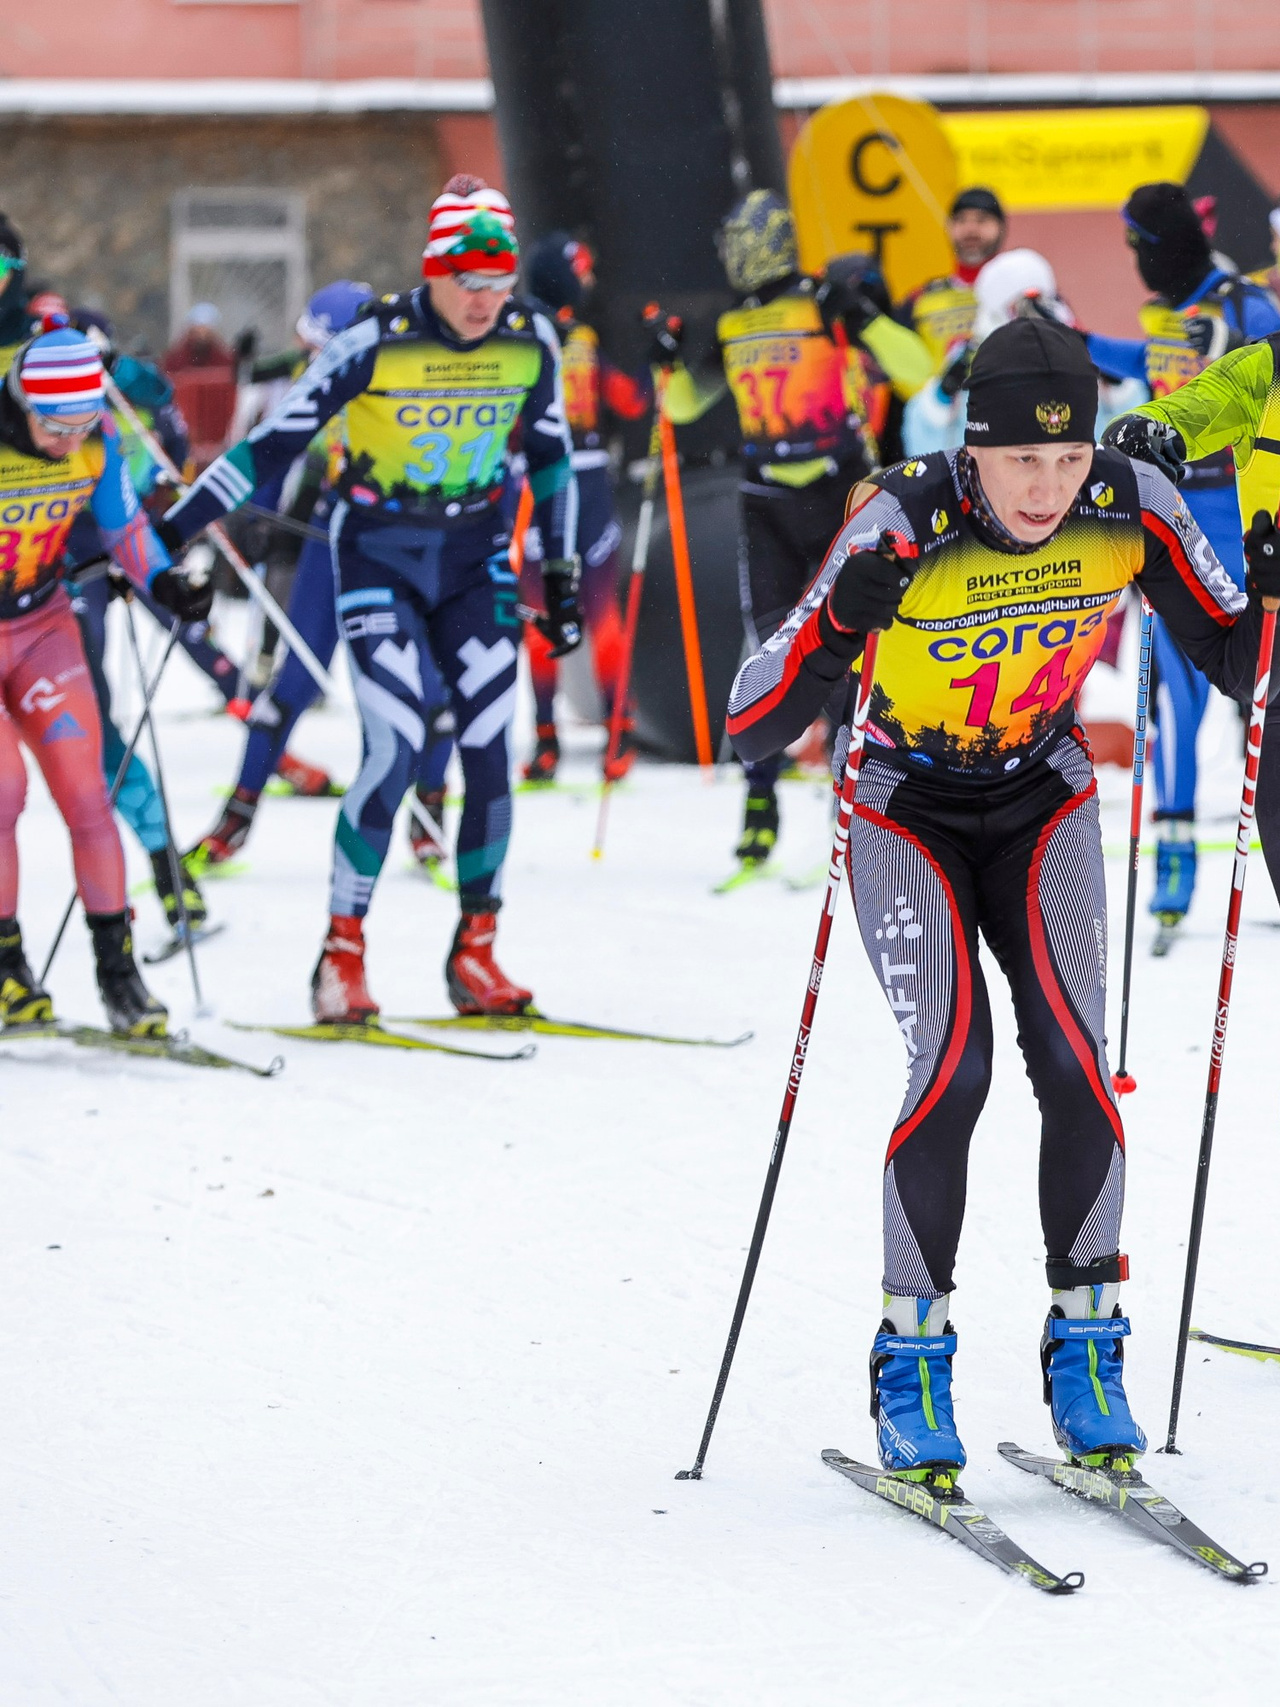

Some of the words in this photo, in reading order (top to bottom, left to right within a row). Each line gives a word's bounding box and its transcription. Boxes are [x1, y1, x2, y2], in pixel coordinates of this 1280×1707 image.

[738, 368, 790, 419] 37
[405, 430, 495, 485] 31
[967, 559, 1082, 592] ВИКТОРИЯ
[967, 588, 1013, 604] вместе
[1015, 585, 1035, 596] мы
[1037, 577, 1081, 593] строим
[915, 607, 999, 632] НОВОГОДНИЙ
[1001, 597, 1081, 617] КОМАНДНЫЙ
[1082, 588, 1121, 608] СПРИН
[949, 645, 1074, 728] 14
[1211, 1002, 1230, 1067] SPORT
[885, 1340, 946, 1350] SPINE
[1068, 1324, 1125, 1334] SPINE
[877, 1405, 919, 1463] SPINE
[875, 1476, 935, 1520] FISCHER
